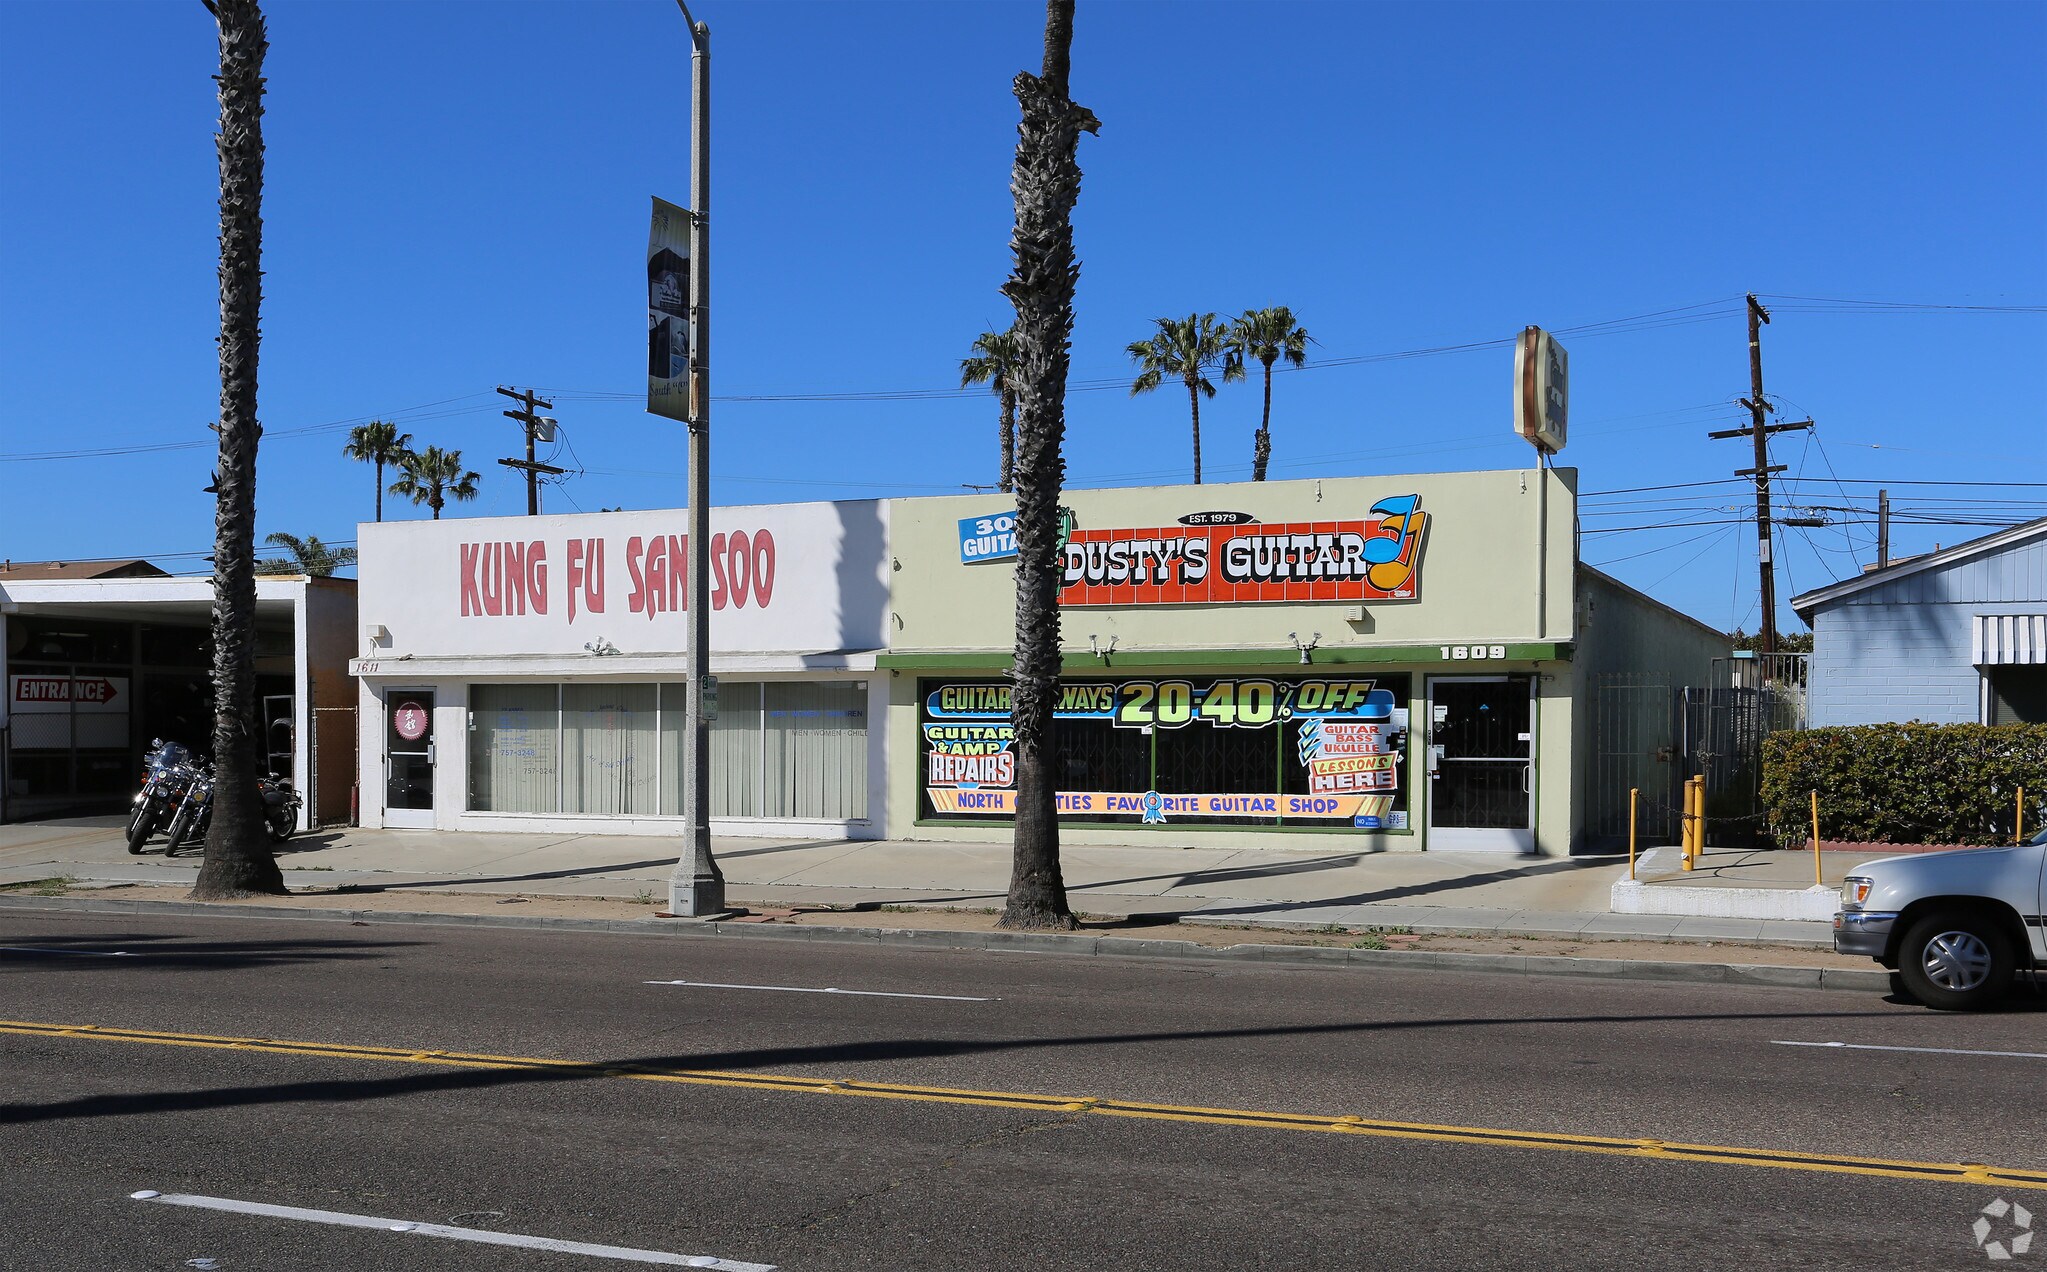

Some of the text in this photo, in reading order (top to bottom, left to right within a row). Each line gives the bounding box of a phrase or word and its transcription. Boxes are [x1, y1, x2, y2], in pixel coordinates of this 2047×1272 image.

[975, 516, 1018, 536] 30
[1189, 513, 1237, 523] EST. 1979
[963, 533, 1019, 557] GUITA
[1063, 533, 1368, 583] DUSTY'S GUITAR
[460, 528, 776, 626] KUNG FU SAN SOO
[1440, 645, 1505, 660] 1609
[356, 662, 379, 673] 1611
[20, 681, 105, 700] ENTRANCE
[942, 687, 1011, 710] GUITAR
[1053, 687, 1113, 710] WAYS
[1297, 682, 1369, 710] OFF
[928, 727, 1014, 740] GUITAR
[1324, 725, 1380, 734] GUITAR
[1335, 734, 1373, 743] BASS
[500, 749, 535, 757] 757-3248
[937, 742, 1000, 754] & AMP
[1324, 743, 1380, 753] UKULELE
[931, 754, 1011, 783] REPAIRS
[1319, 757, 1388, 773] LESSONS
[1314, 771, 1392, 790] HERE
[957, 792, 1004, 809] NORTH
[1106, 797, 1200, 812] FAVRITE
[1209, 798, 1276, 812] GUITAR
[1289, 799, 1339, 814] SHOP
